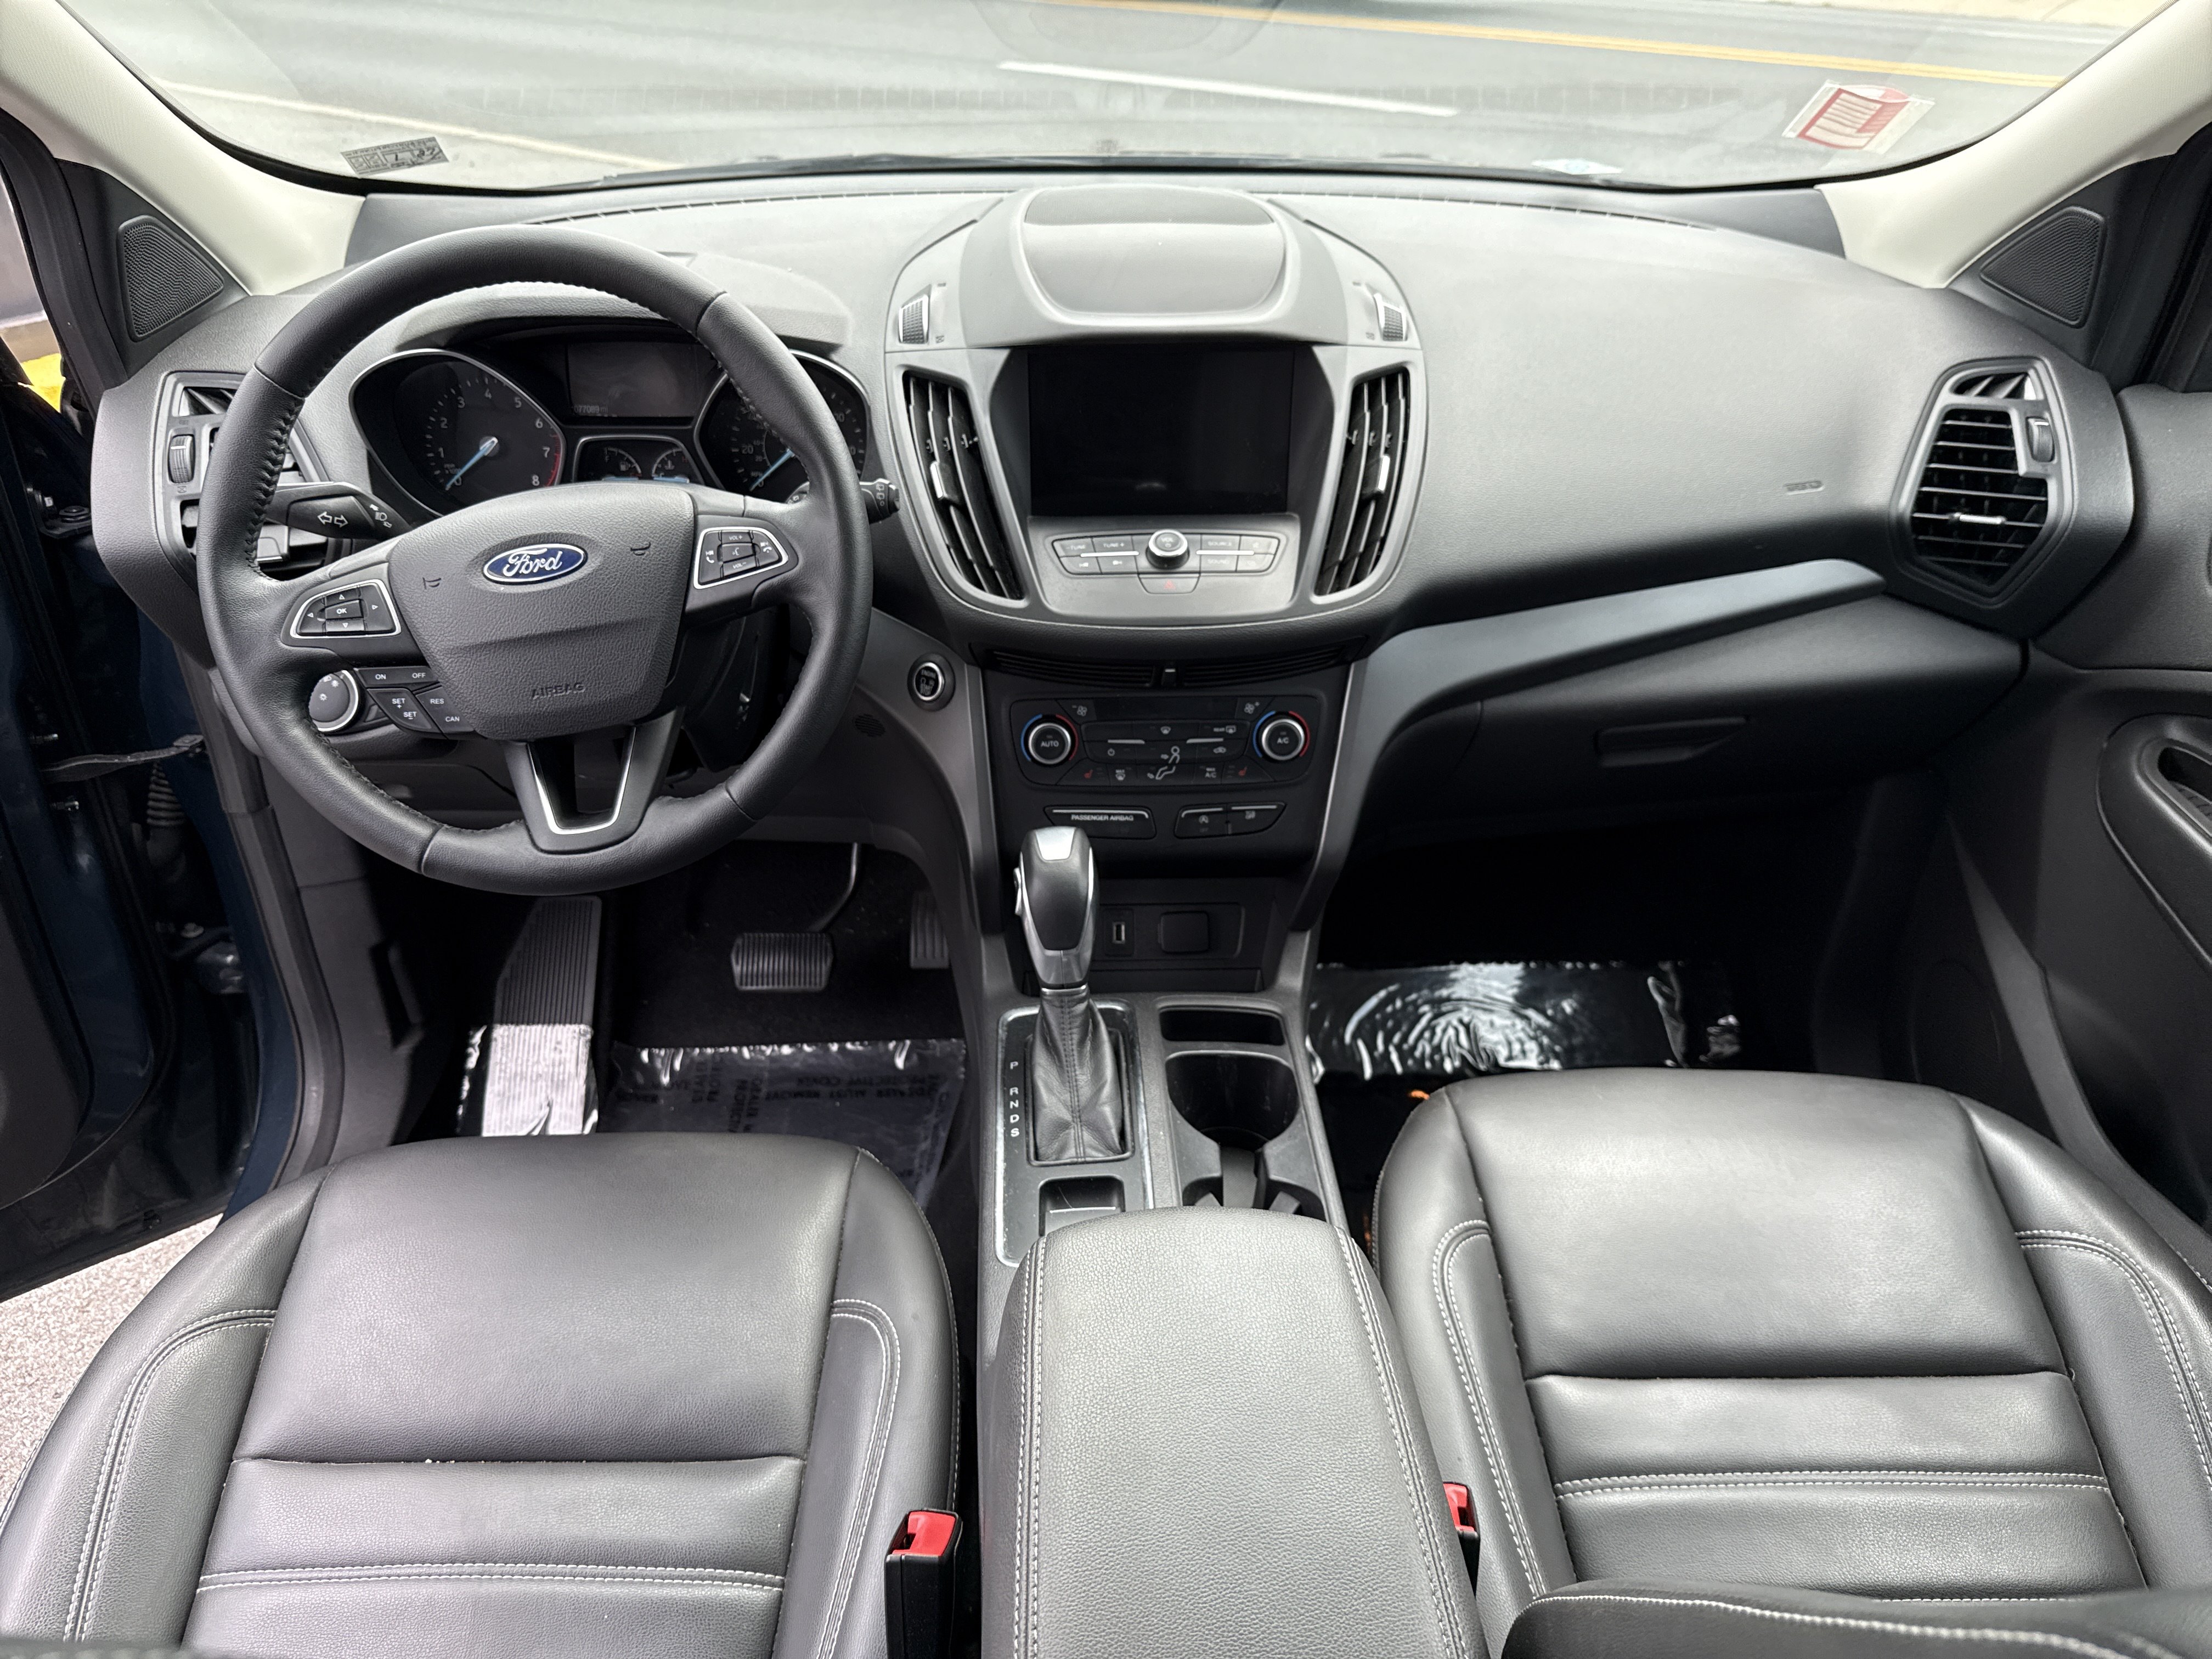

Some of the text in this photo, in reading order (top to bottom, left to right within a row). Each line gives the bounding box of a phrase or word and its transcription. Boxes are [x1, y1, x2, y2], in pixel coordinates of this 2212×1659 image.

[484, 388, 492, 399] 4
[457, 397, 465, 409] 3
[514, 397, 522, 409] 5
[441, 417, 448, 428] 2
[535, 417, 543, 428] 6
[439, 447, 444, 458] 1
[543, 447, 550, 458] 7
[742, 443, 754, 455] 20
[532, 475, 540, 487] 8
[502, 548, 563, 577] Ford
[531, 682, 586, 699] AIRBAG
[1009, 1061, 1019, 1069] P
[1009, 1087, 1019, 1095] R
[1009, 1100, 1019, 1109] N
[1009, 1114, 1019, 1124] D
[1011, 1127, 1020, 1137] S
